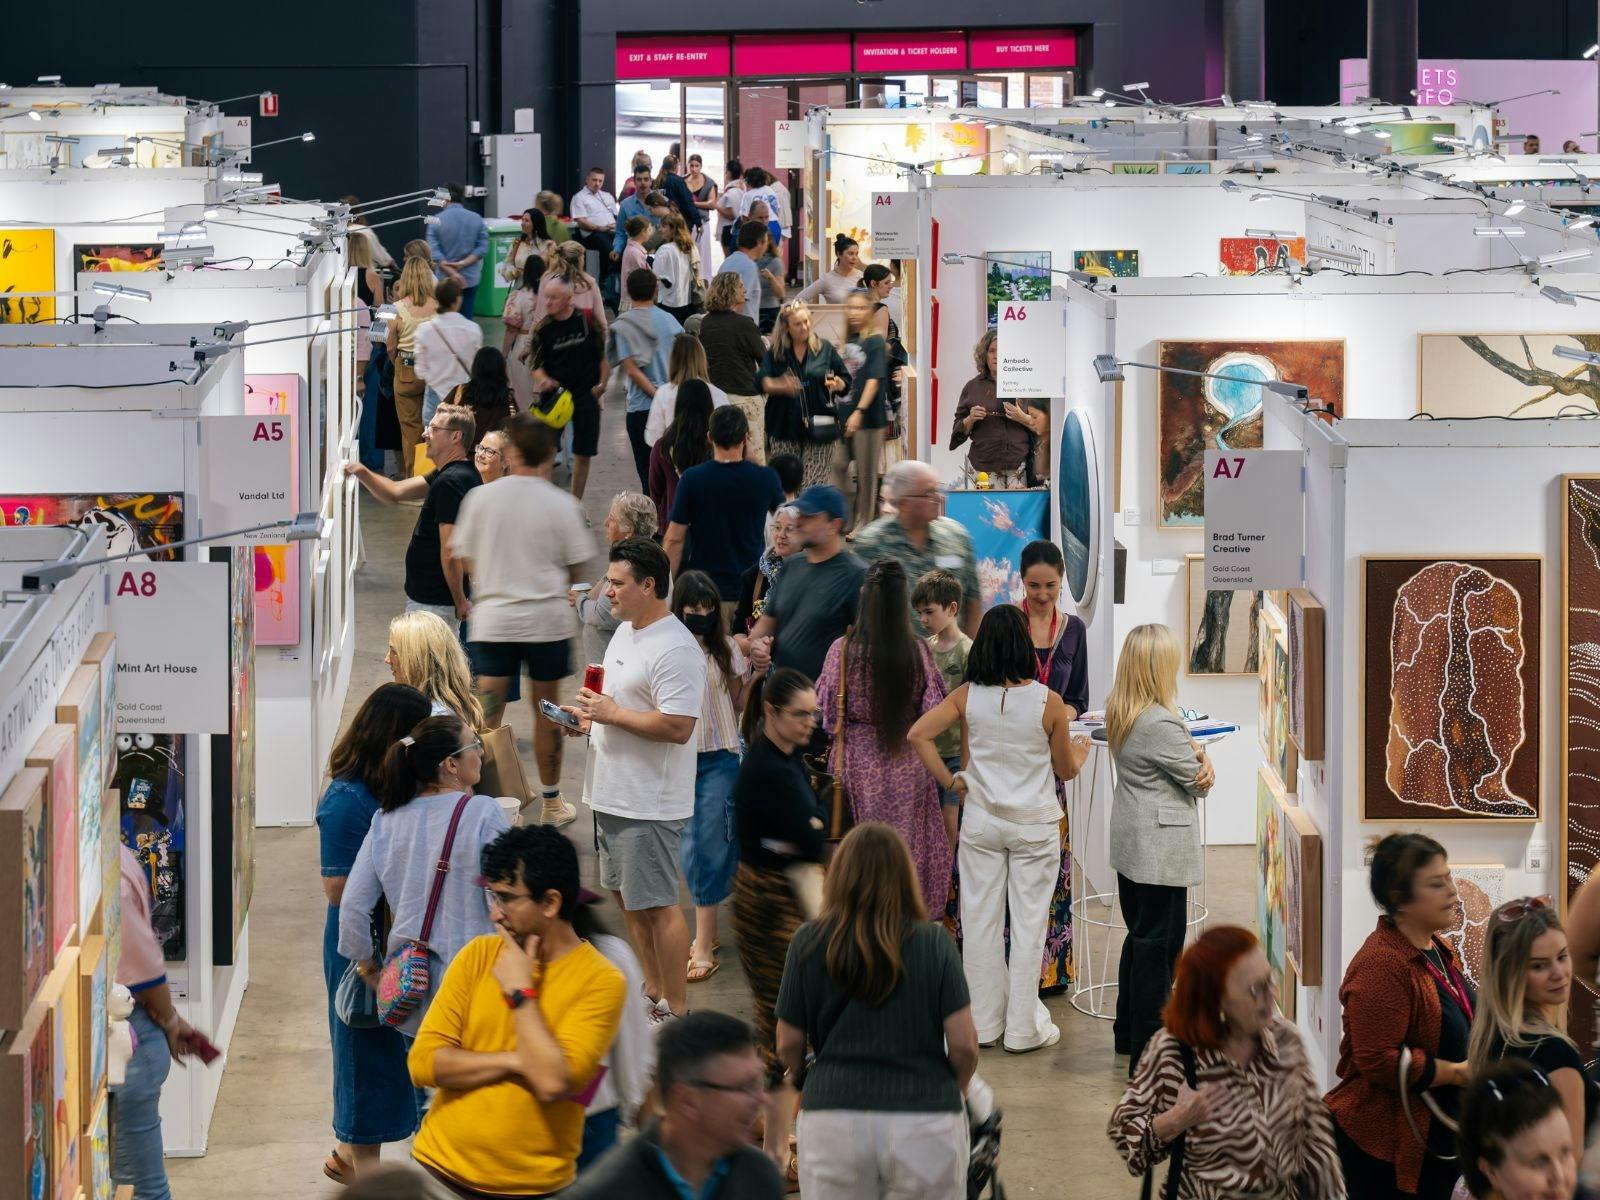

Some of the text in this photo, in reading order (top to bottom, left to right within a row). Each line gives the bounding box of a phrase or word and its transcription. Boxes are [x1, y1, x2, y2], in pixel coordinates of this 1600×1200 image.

[863, 48, 899, 56] INVITATION
[908, 47, 928, 55] TICKET
[930, 47, 958, 55] HOLDERS
[996, 44, 1050, 53] BUY TICKETS HERE
[629, 54, 644, 62] EXIT
[654, 53, 673, 62] STAFF
[676, 52, 708, 61] RE-ENTRY
[237, 119, 248, 127] A3
[778, 123, 790, 131] A2
[875, 195, 892, 206] A4
[1003, 306, 1027, 321] A6
[252, 422, 284, 442] A5
[1212, 457, 1246, 479] A7
[238, 492, 285, 500] Vandal Ltd
[1212, 533, 1266, 541] Brad Turner
[1212, 544, 1251, 553] Creative
[116, 571, 157, 597] A8
[117, 663, 198, 673] Mint Art House
[116, 702, 162, 711] Gold Coast
[116, 716, 166, 725] Queensland
